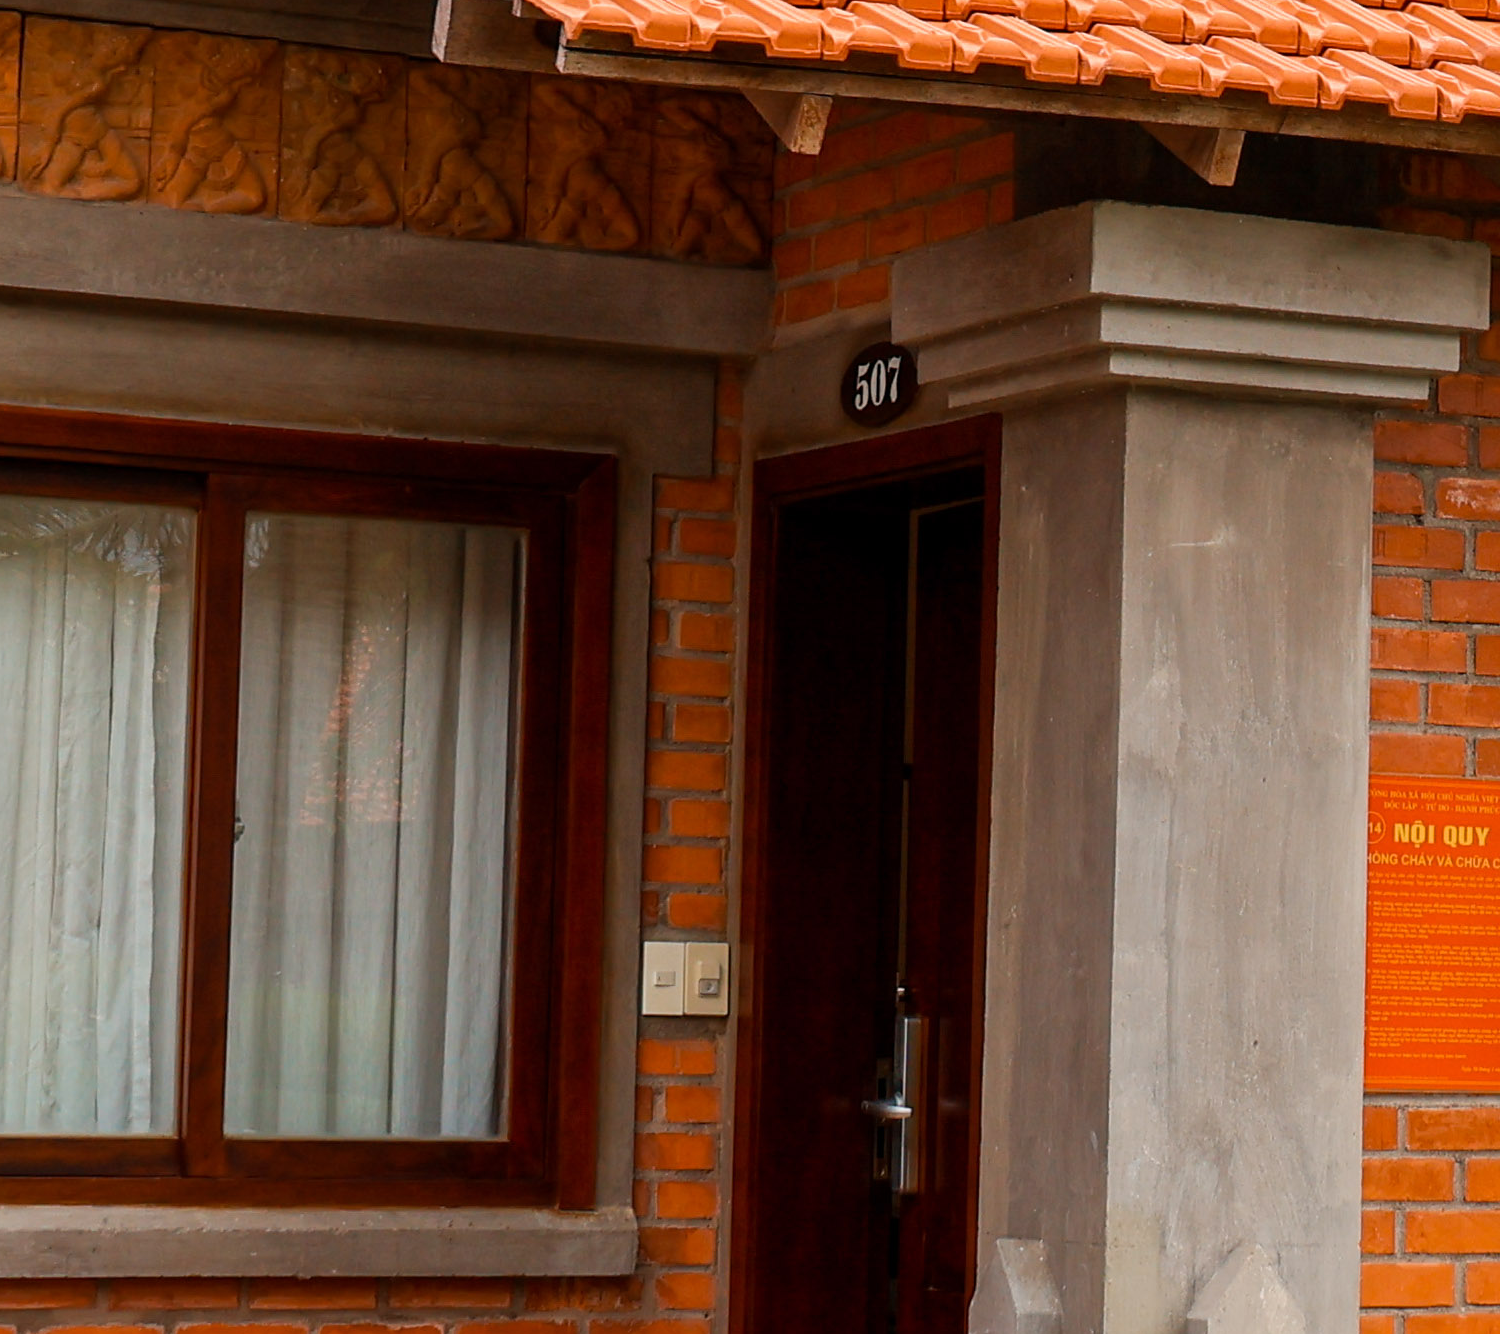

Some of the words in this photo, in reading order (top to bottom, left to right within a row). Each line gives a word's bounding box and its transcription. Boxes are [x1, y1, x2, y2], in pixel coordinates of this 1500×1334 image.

[855, 356, 901, 410] 507
[1394, 820, 1435, 848] NỘI
[1443, 824, 1490, 848] QUY
[1401, 852, 1435, 866] CHÁY
[1436, 854, 1453, 867] VÀ
[1456, 855, 1491, 869] CHỮA
